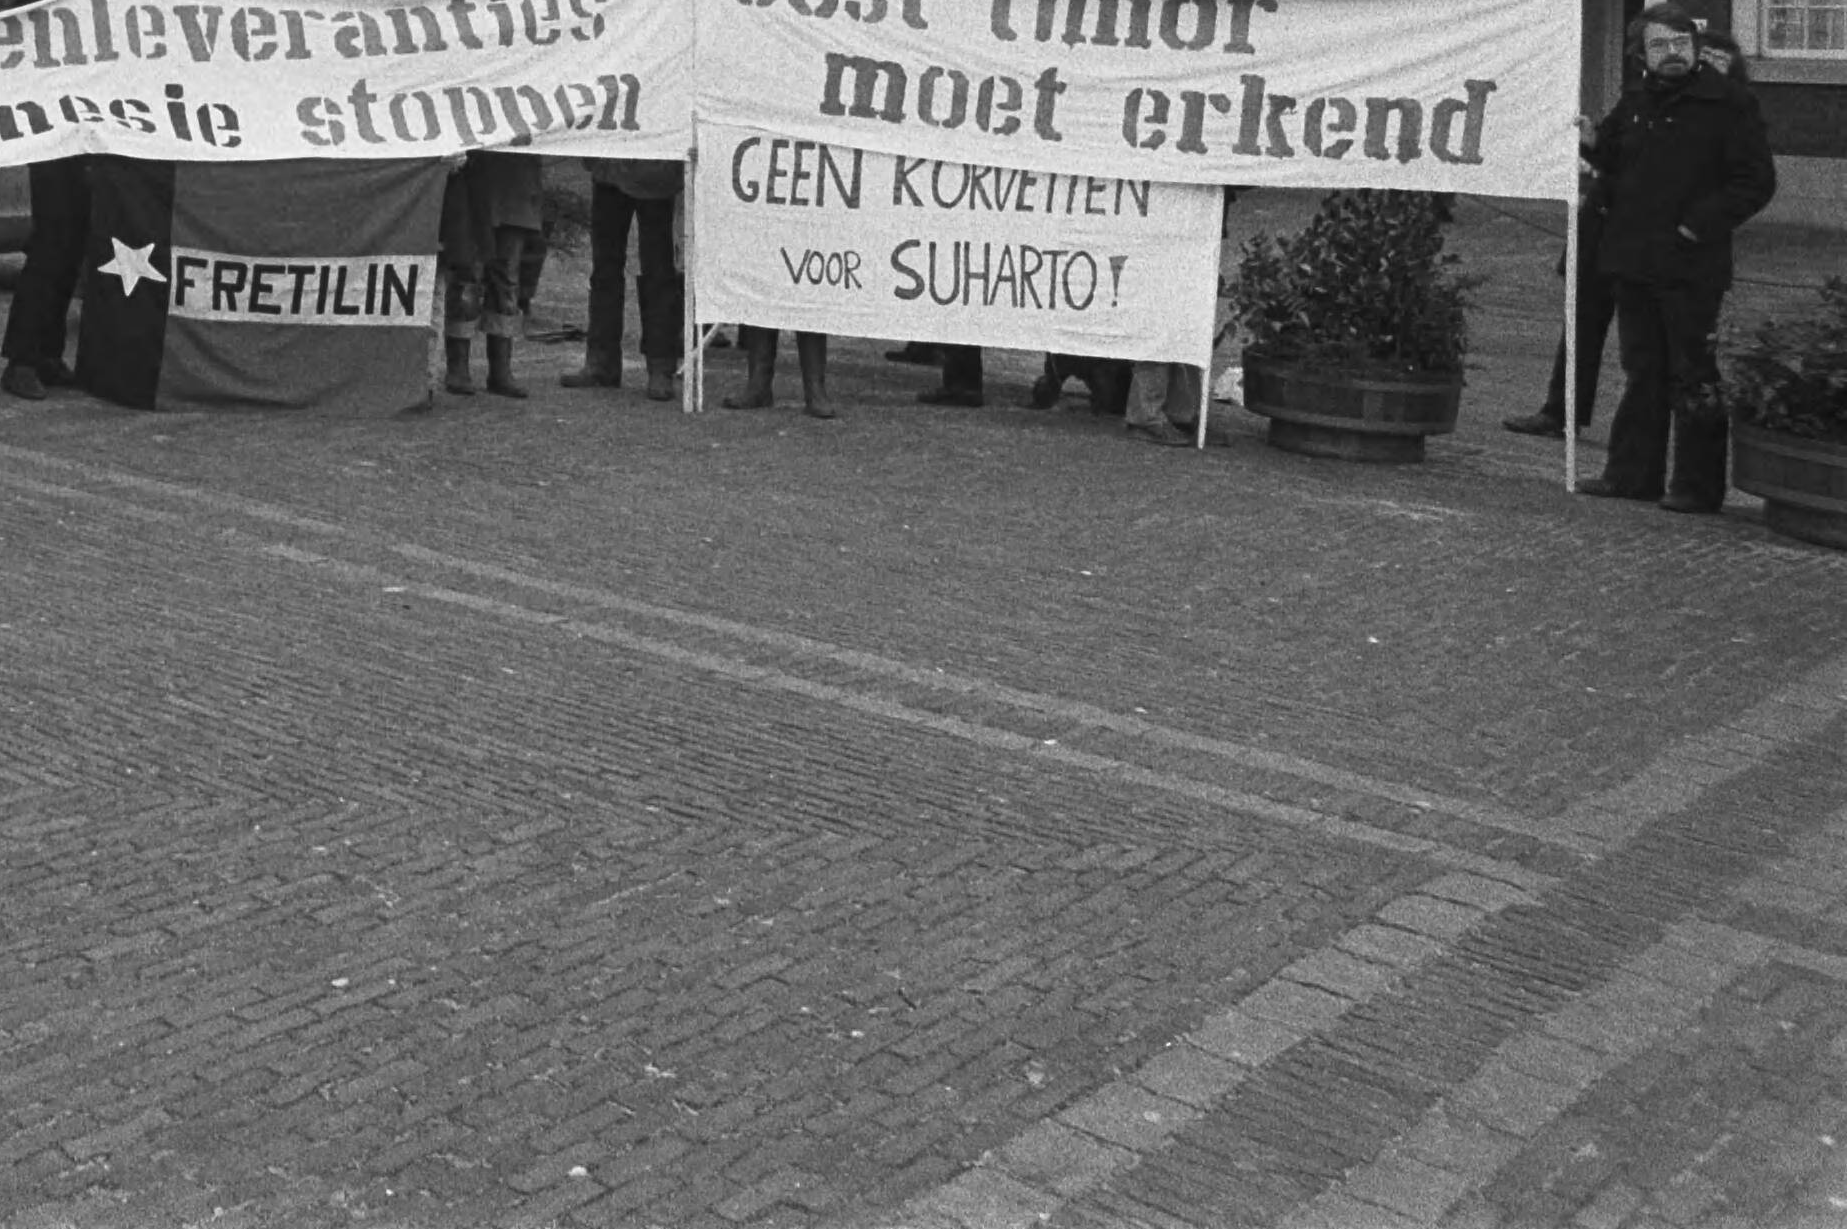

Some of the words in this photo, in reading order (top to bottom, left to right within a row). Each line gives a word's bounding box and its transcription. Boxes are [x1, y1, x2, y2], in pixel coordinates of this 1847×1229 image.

[295, 72, 641, 148] stoppen
[819, 50, 1068, 142] moet
[1121, 73, 1498, 166] erkend
[731, 136, 864, 210] GEEN
[174, 255, 419, 317] FRETILIN
[780, 246, 862, 290] VOOR
